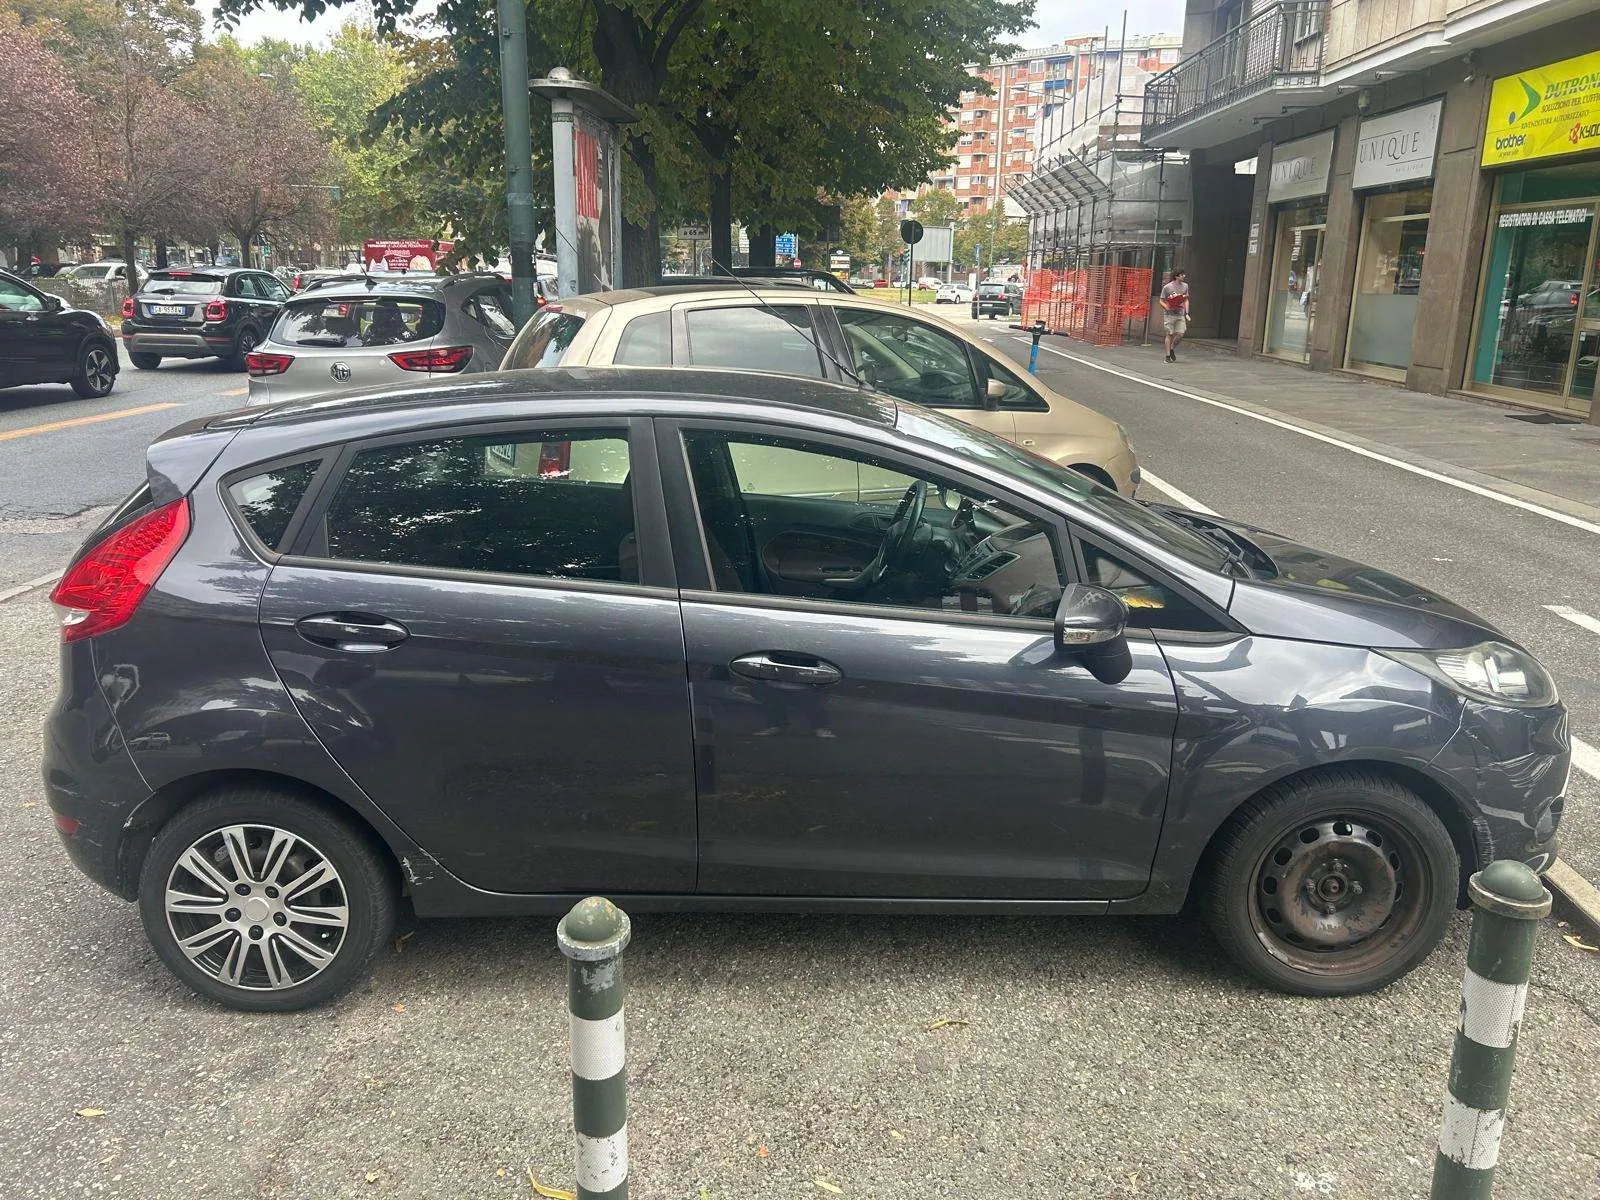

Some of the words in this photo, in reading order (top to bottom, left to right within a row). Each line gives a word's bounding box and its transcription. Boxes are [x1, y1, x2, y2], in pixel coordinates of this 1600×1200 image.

[1359, 131, 1420, 164] UNIQUE
[1495, 134, 1526, 150] brother
[1272, 156, 1317, 181] UNIQUE
[1532, 211, 1539, 226] DI
[1539, 210, 1555, 225] CASSA
